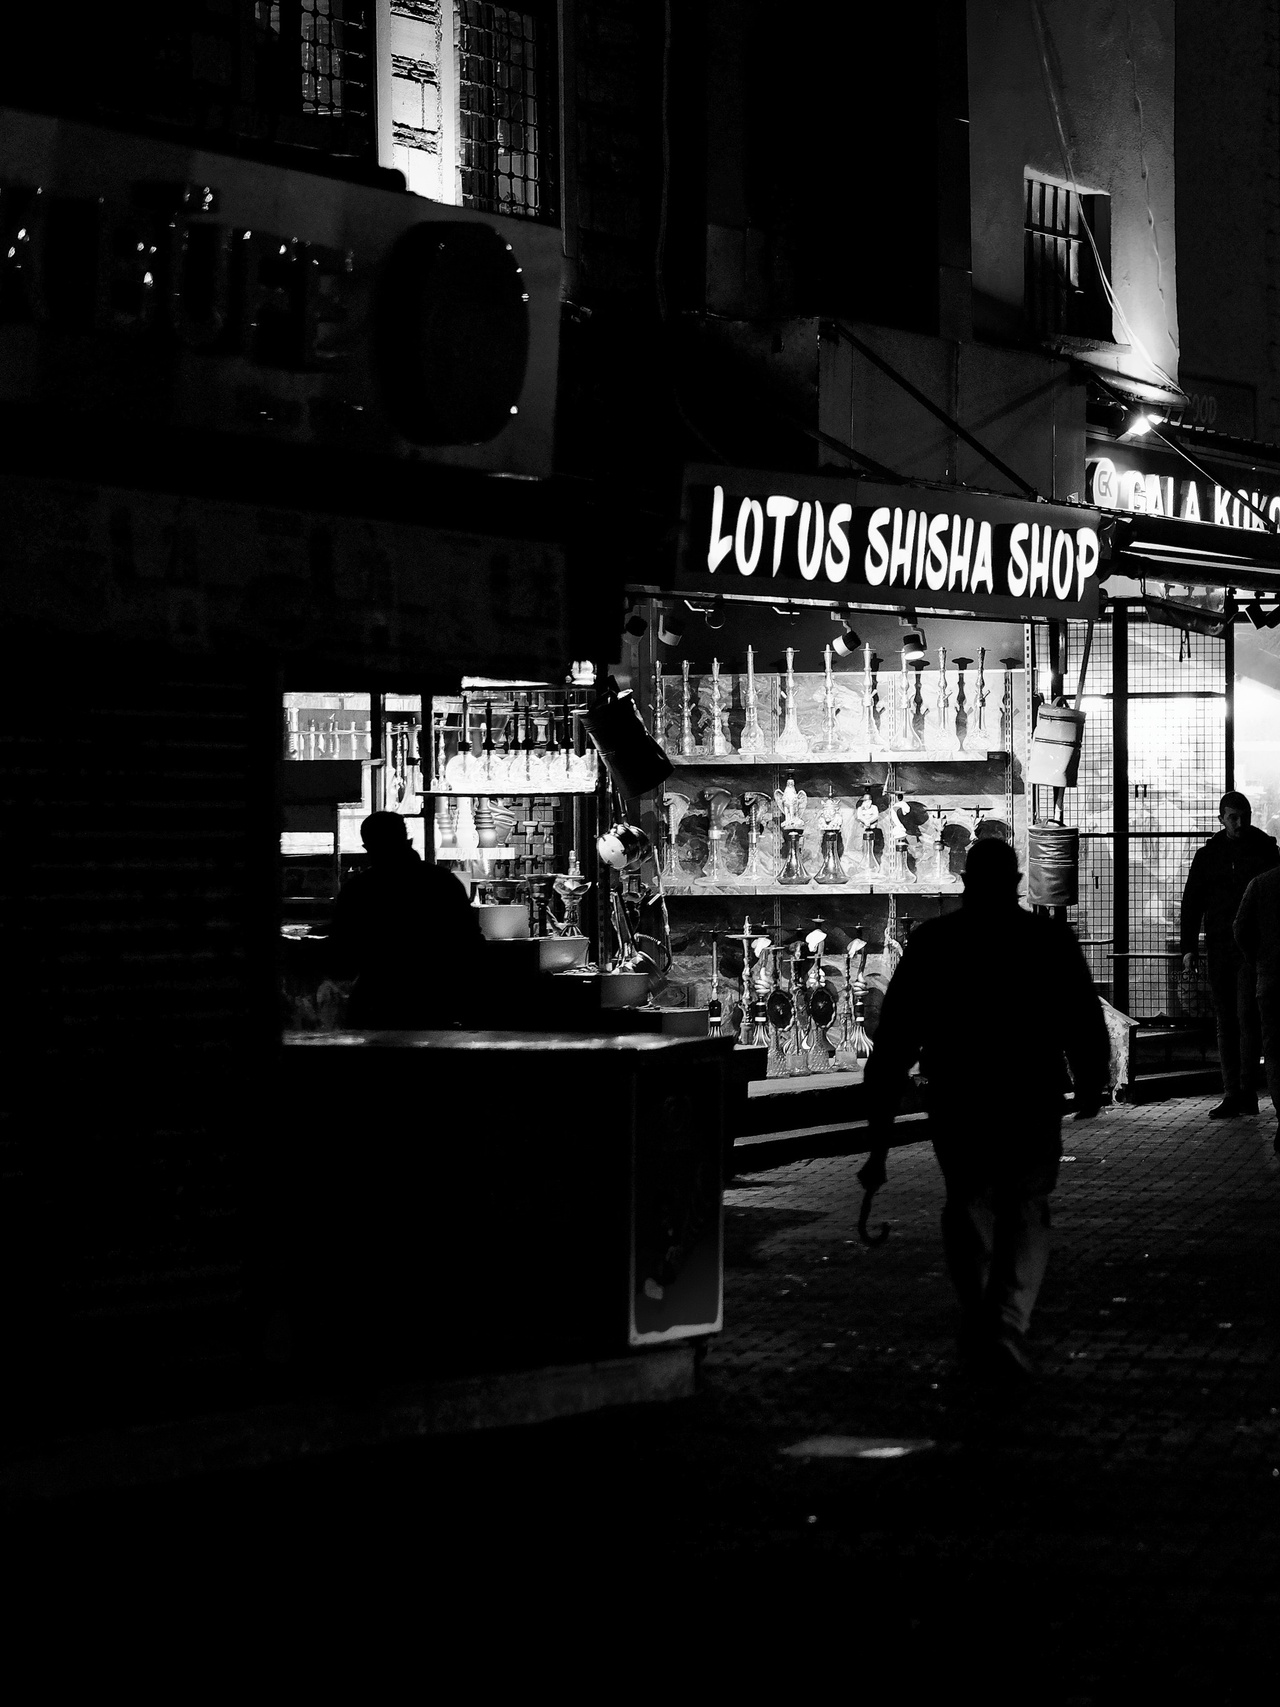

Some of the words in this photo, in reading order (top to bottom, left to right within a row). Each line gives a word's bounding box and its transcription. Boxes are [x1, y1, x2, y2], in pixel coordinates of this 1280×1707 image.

[708, 486, 852, 582] LOTUS
[865, 508, 993, 594] SHISHA
[1008, 523, 1098, 601] SHOP
